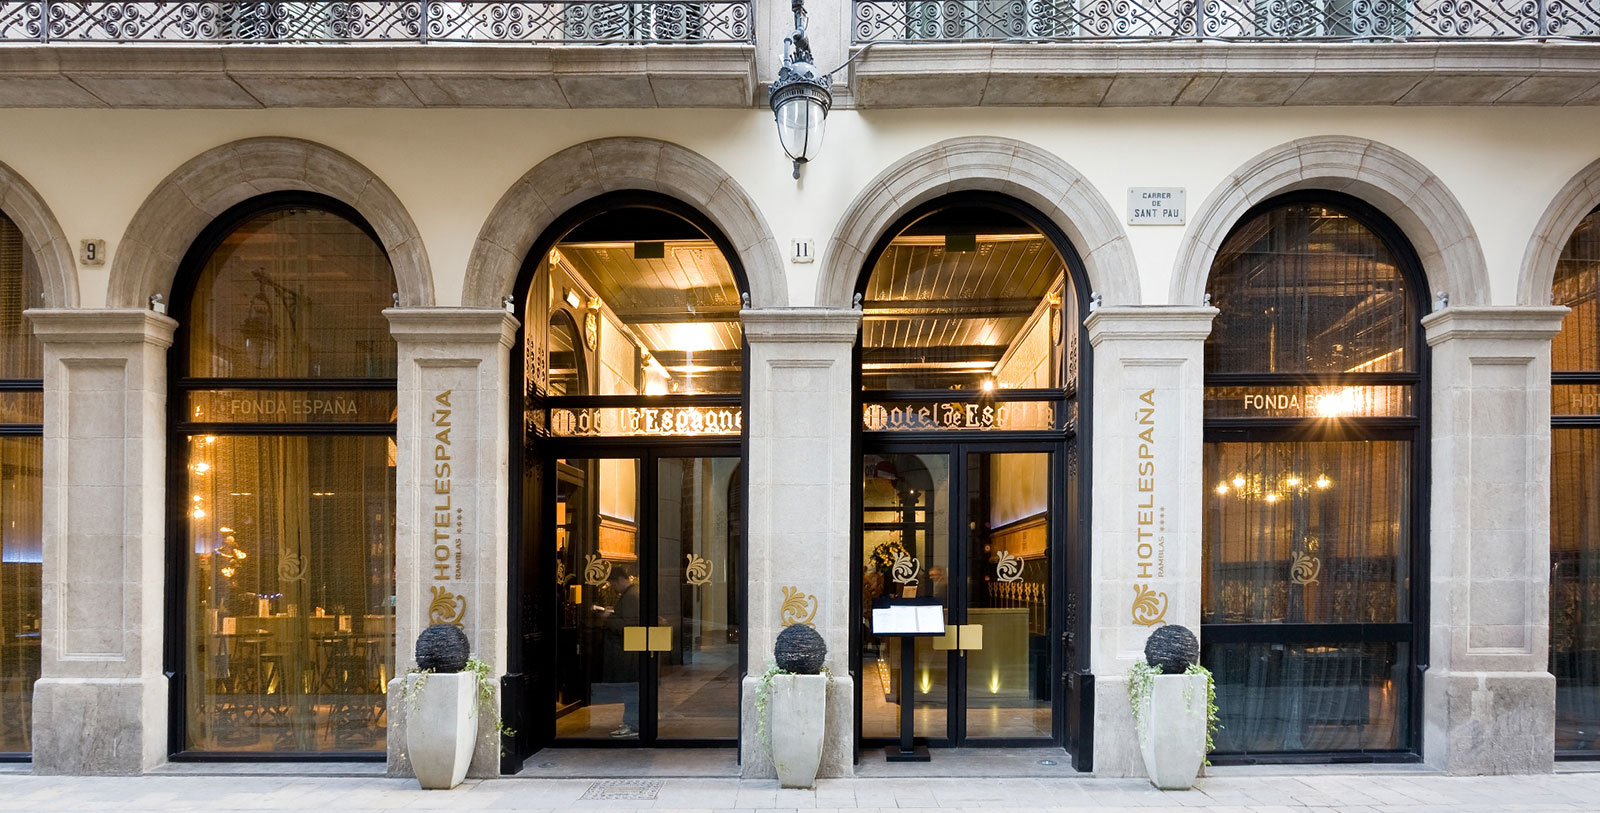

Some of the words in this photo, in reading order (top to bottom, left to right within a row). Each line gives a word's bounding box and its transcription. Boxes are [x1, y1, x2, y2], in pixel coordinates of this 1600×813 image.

[1134, 208, 1157, 218] SANT
[1162, 208, 1179, 218] PAU
[87, 243, 96, 261] 9
[796, 242, 808, 257] 11
[231, 399, 287, 415] FONDA
[292, 396, 358, 415] ESPAÑA
[1244, 394, 1299, 410] FONDA
[552, 408, 626, 437] Hôtl
[940, 403, 962, 426] de
